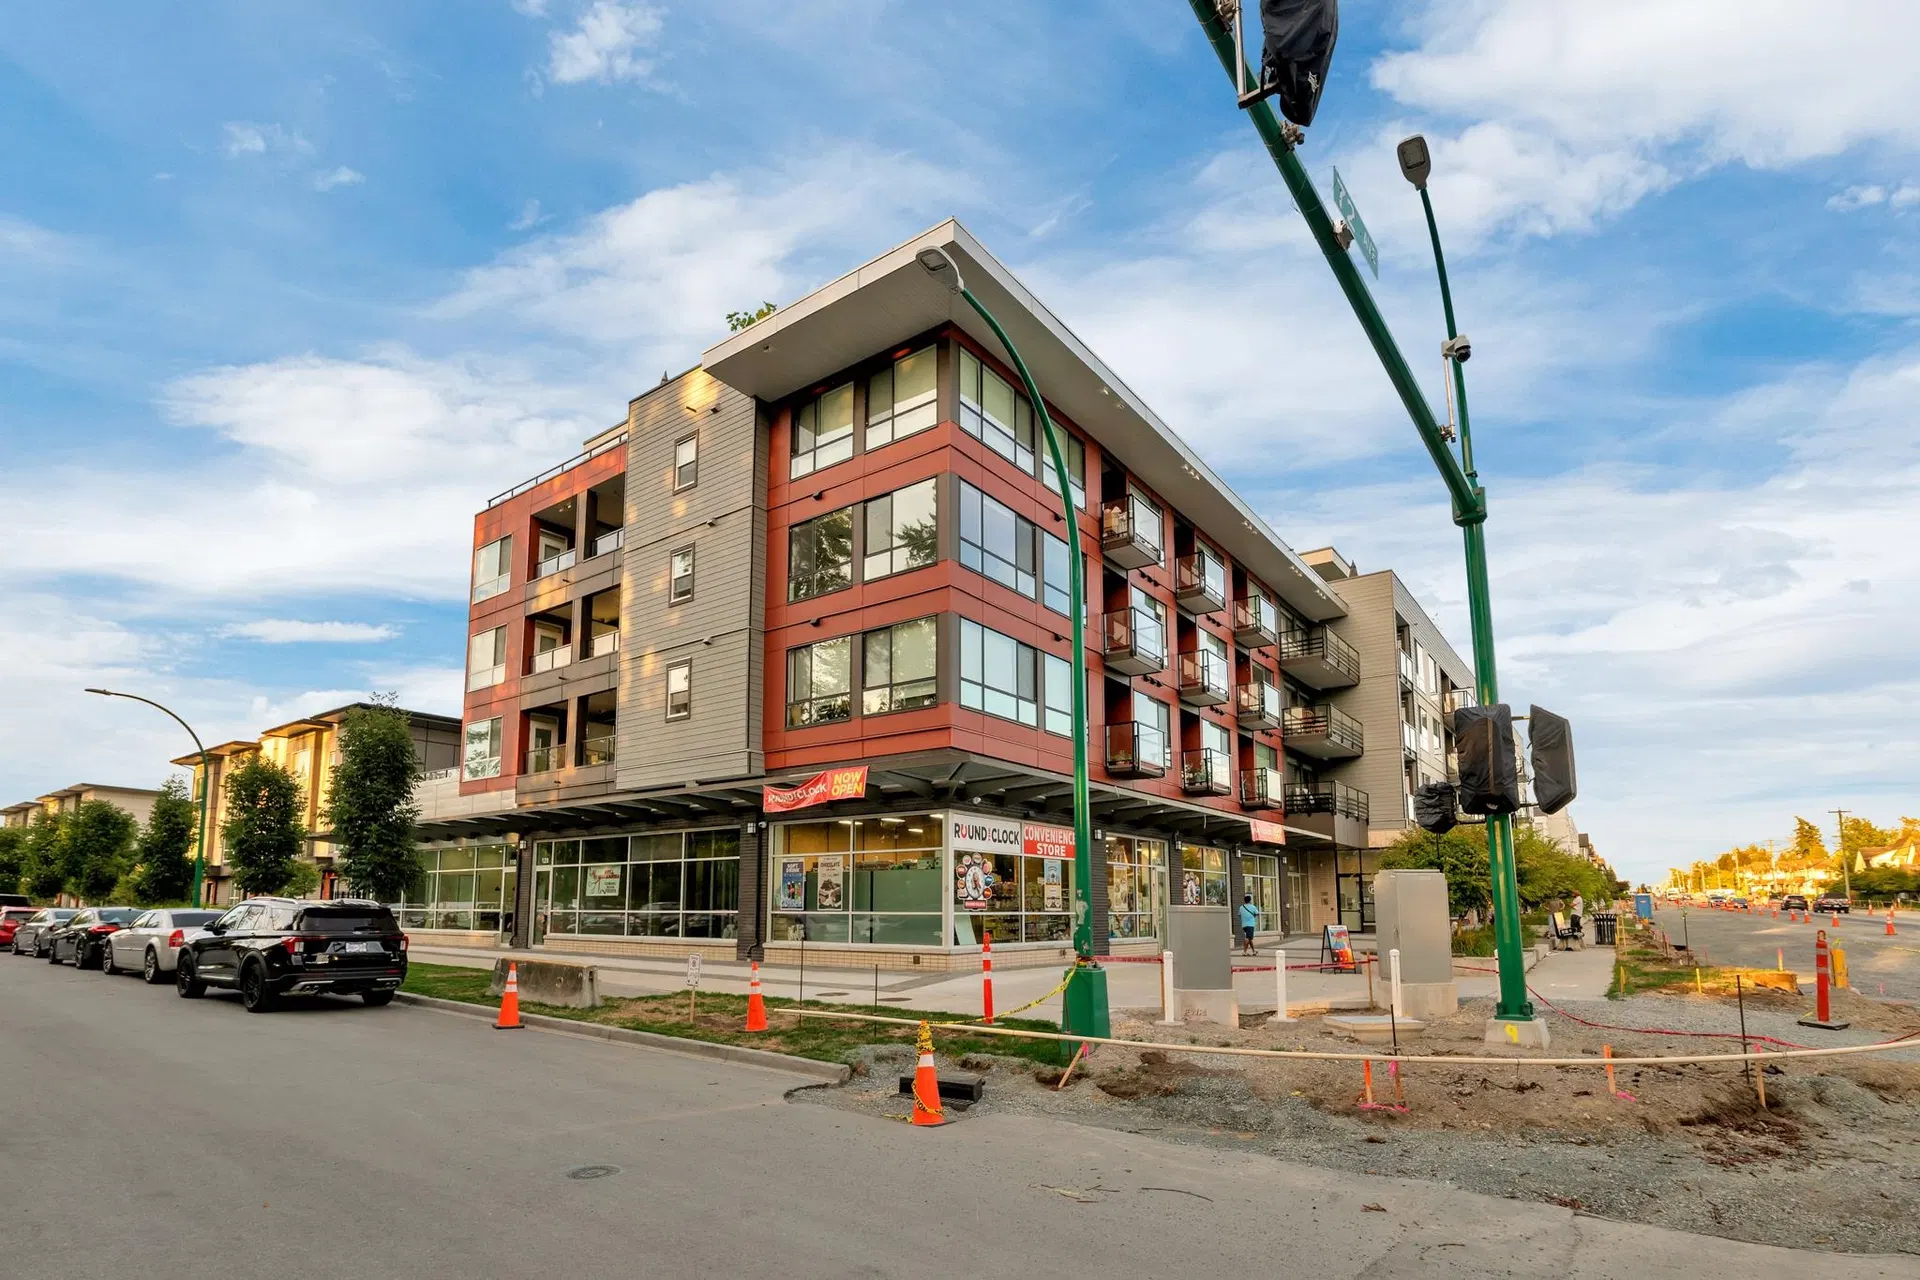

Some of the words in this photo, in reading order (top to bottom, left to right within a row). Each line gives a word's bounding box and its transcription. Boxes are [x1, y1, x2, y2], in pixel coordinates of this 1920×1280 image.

[1337, 177, 1355, 233] 72
[834, 771, 862, 785] NOW
[796, 783, 827, 799] CLOCK
[831, 783, 863, 796] OPEN
[955, 823, 987, 841] ROUND
[991, 827, 1020, 846] CLOCK
[1037, 843, 1066, 857] STORE
